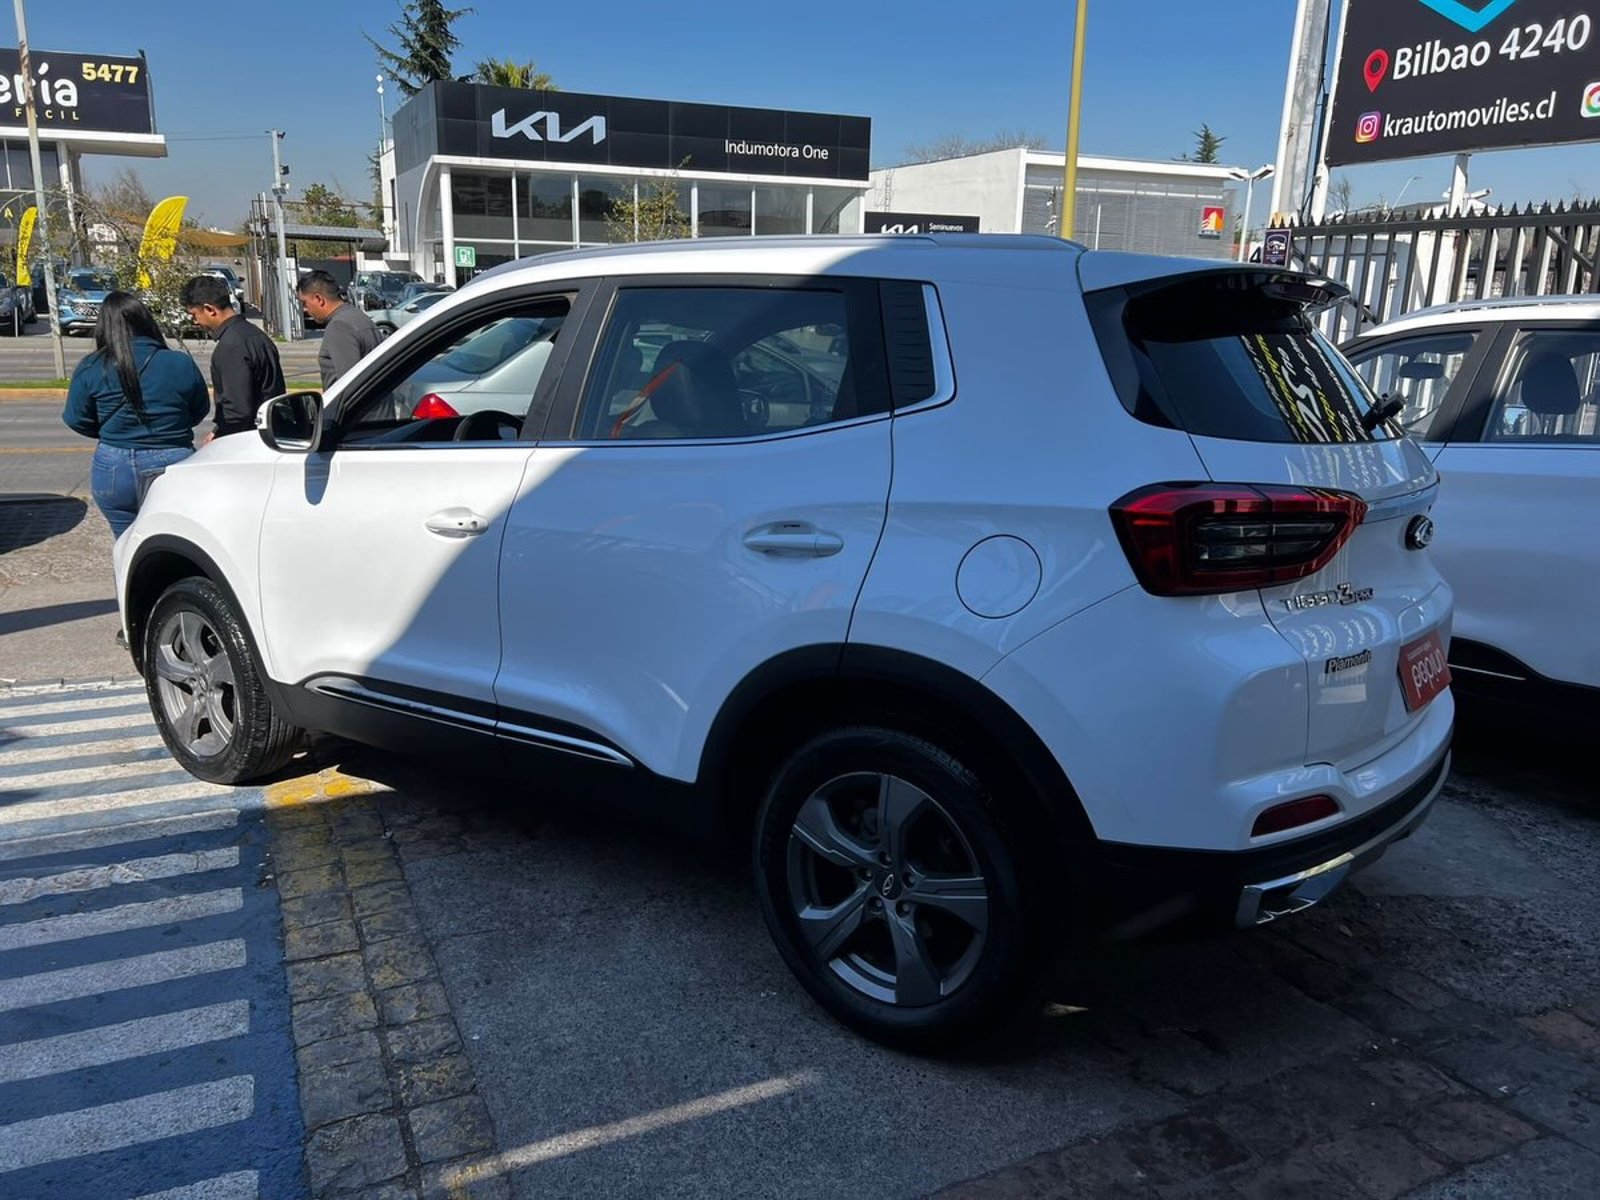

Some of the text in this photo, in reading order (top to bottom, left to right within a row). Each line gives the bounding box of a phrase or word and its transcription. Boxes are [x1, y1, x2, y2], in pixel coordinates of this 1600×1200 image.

[1392, 14, 1591, 80] Bilbao 4240
[82, 62, 139, 84] 5477
[15, 108, 79, 121] FCIL
[1383, 91, 1557, 137] krautomoviles.cl
[491, 108, 606, 145] KIA
[724, 138, 829, 160] Indumotora One
[881, 223, 918, 234] KIA
[928, 222, 964, 232] Seminuevos
